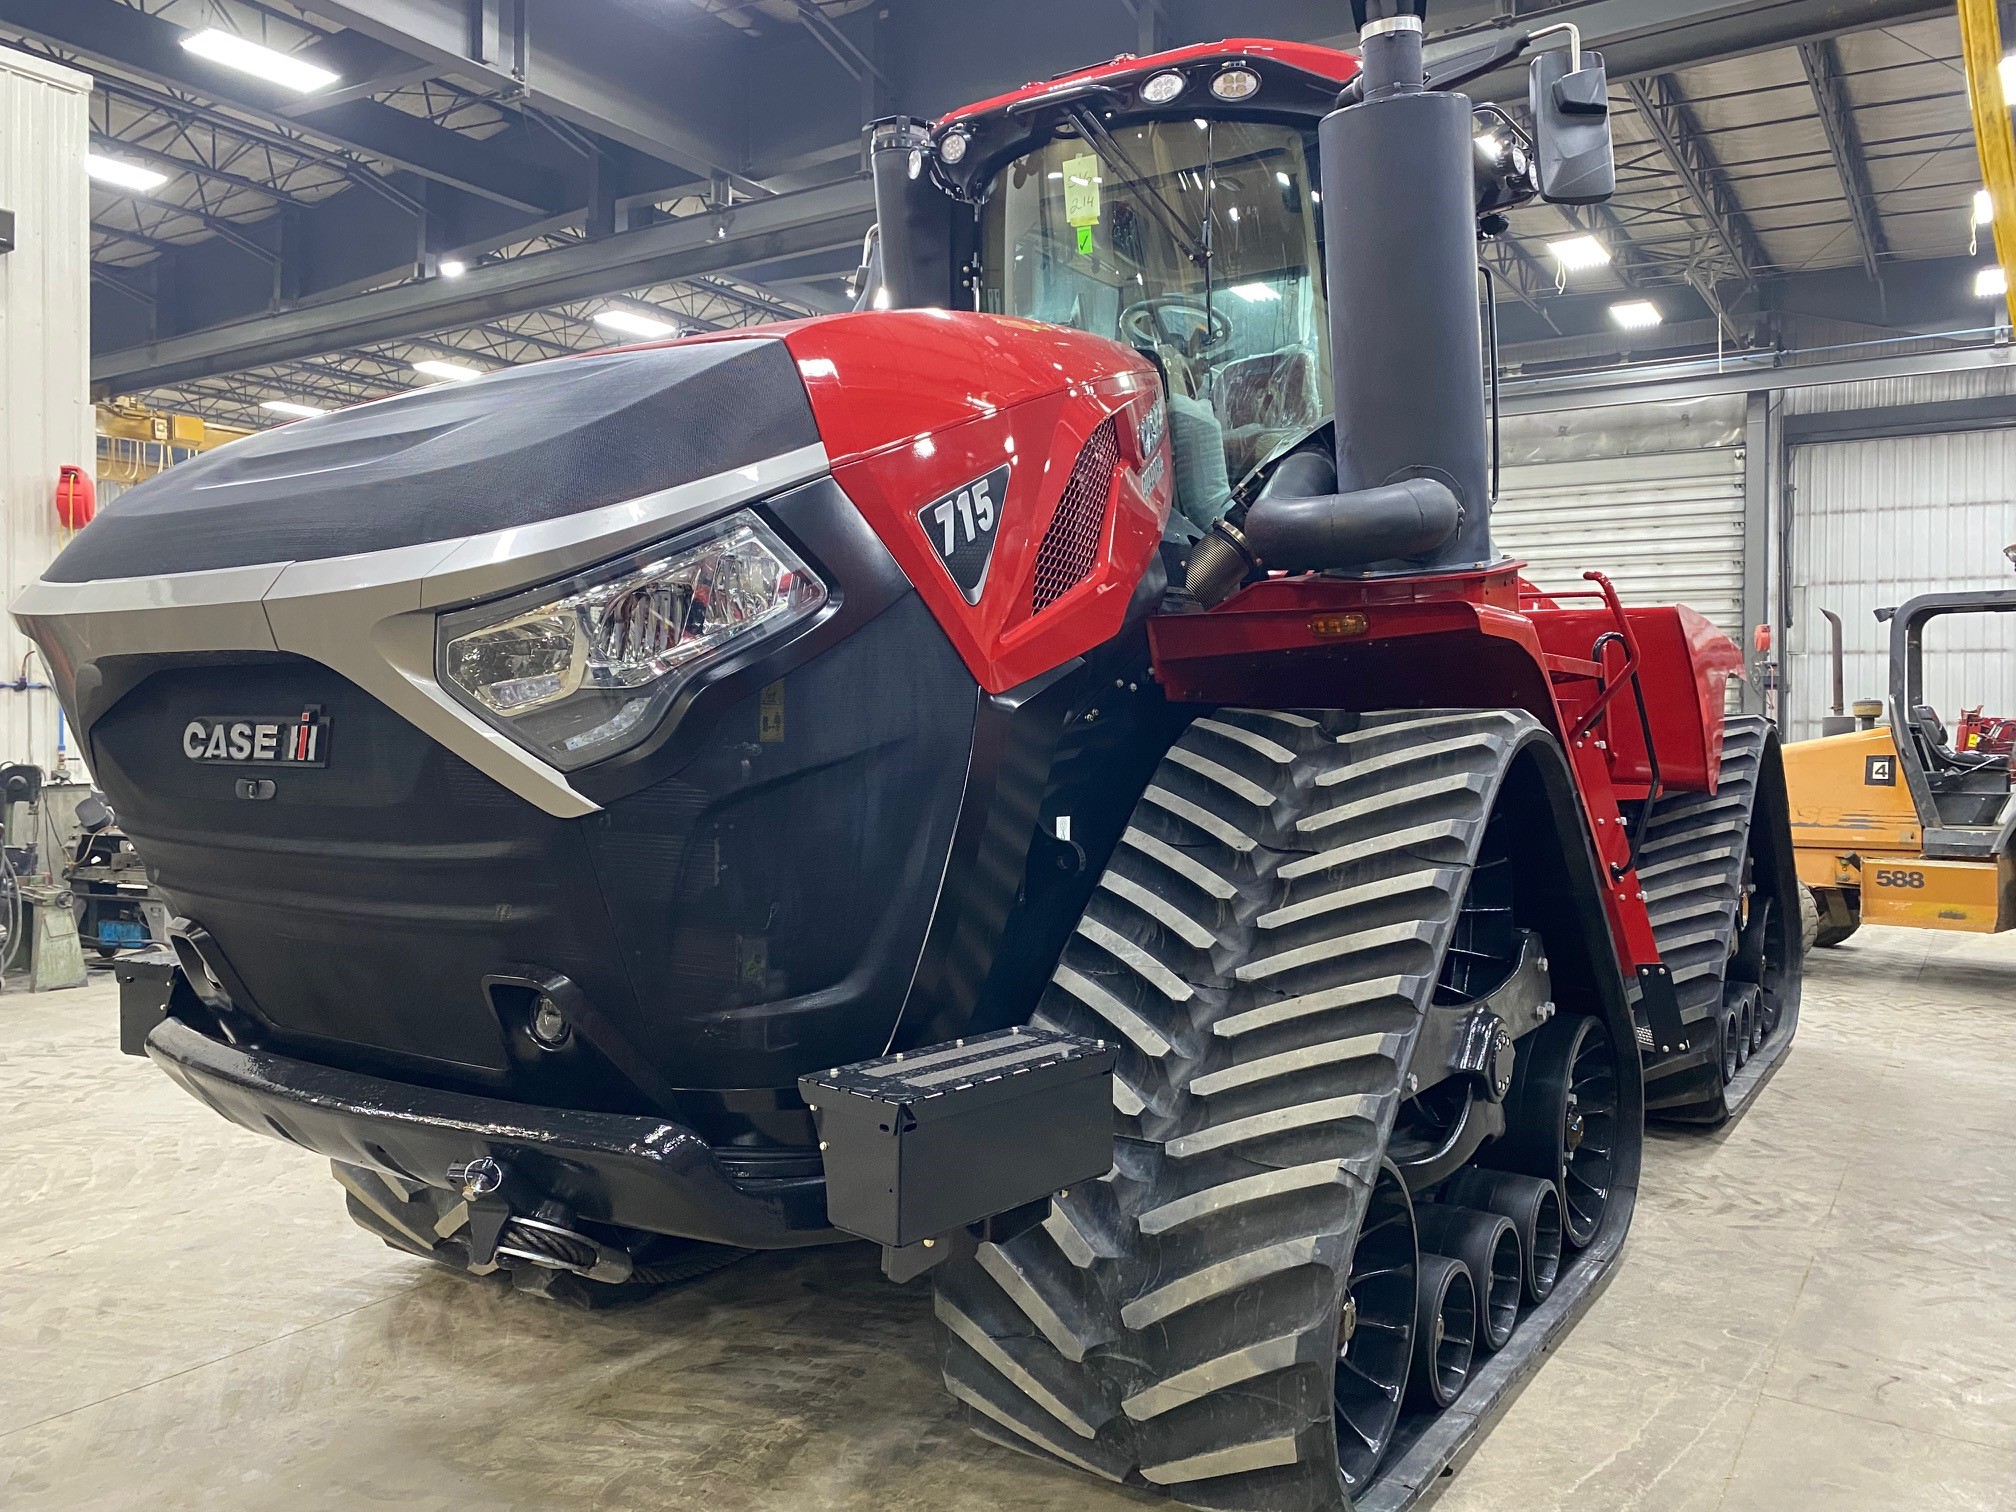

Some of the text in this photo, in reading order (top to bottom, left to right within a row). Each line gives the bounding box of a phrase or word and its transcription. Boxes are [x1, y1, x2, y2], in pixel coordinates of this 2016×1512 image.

[1070, 196, 1094, 214] 214
[934, 478, 994, 557] 715
[183, 721, 278, 760] CASE
[1874, 764, 1888, 778] 4
[1876, 869, 1925, 889] 588
